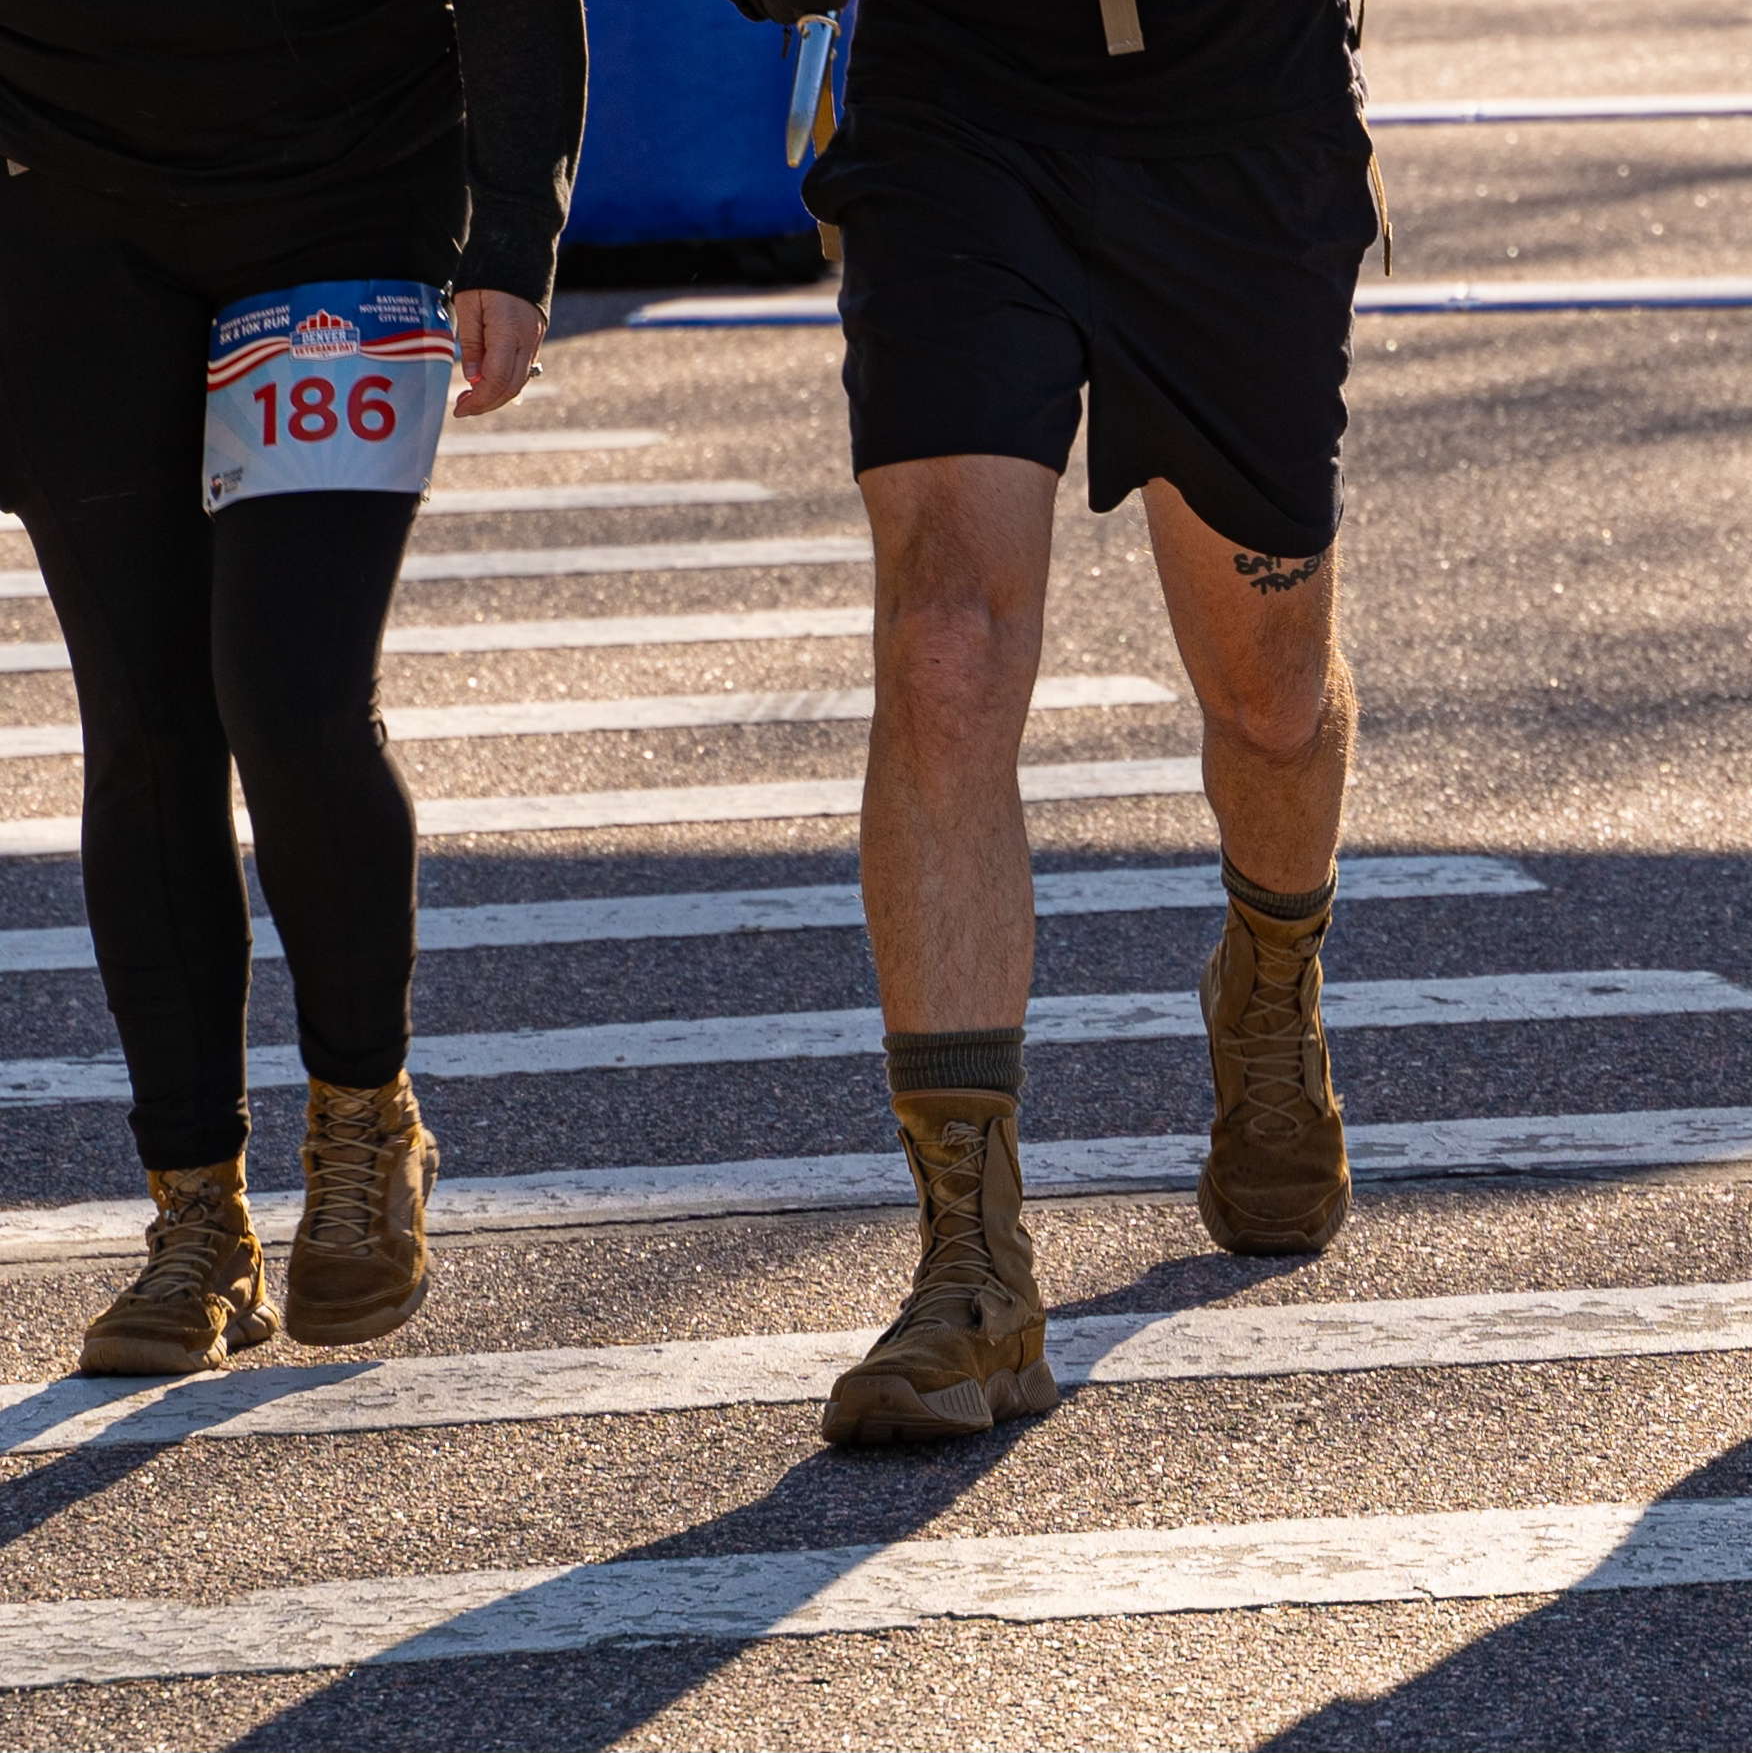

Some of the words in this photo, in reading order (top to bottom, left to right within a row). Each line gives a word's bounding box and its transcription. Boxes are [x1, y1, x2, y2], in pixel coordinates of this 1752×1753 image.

[263, 315, 290, 330] RUN
[301, 329, 346, 345] DENVER
[252, 374, 396, 447] 186
